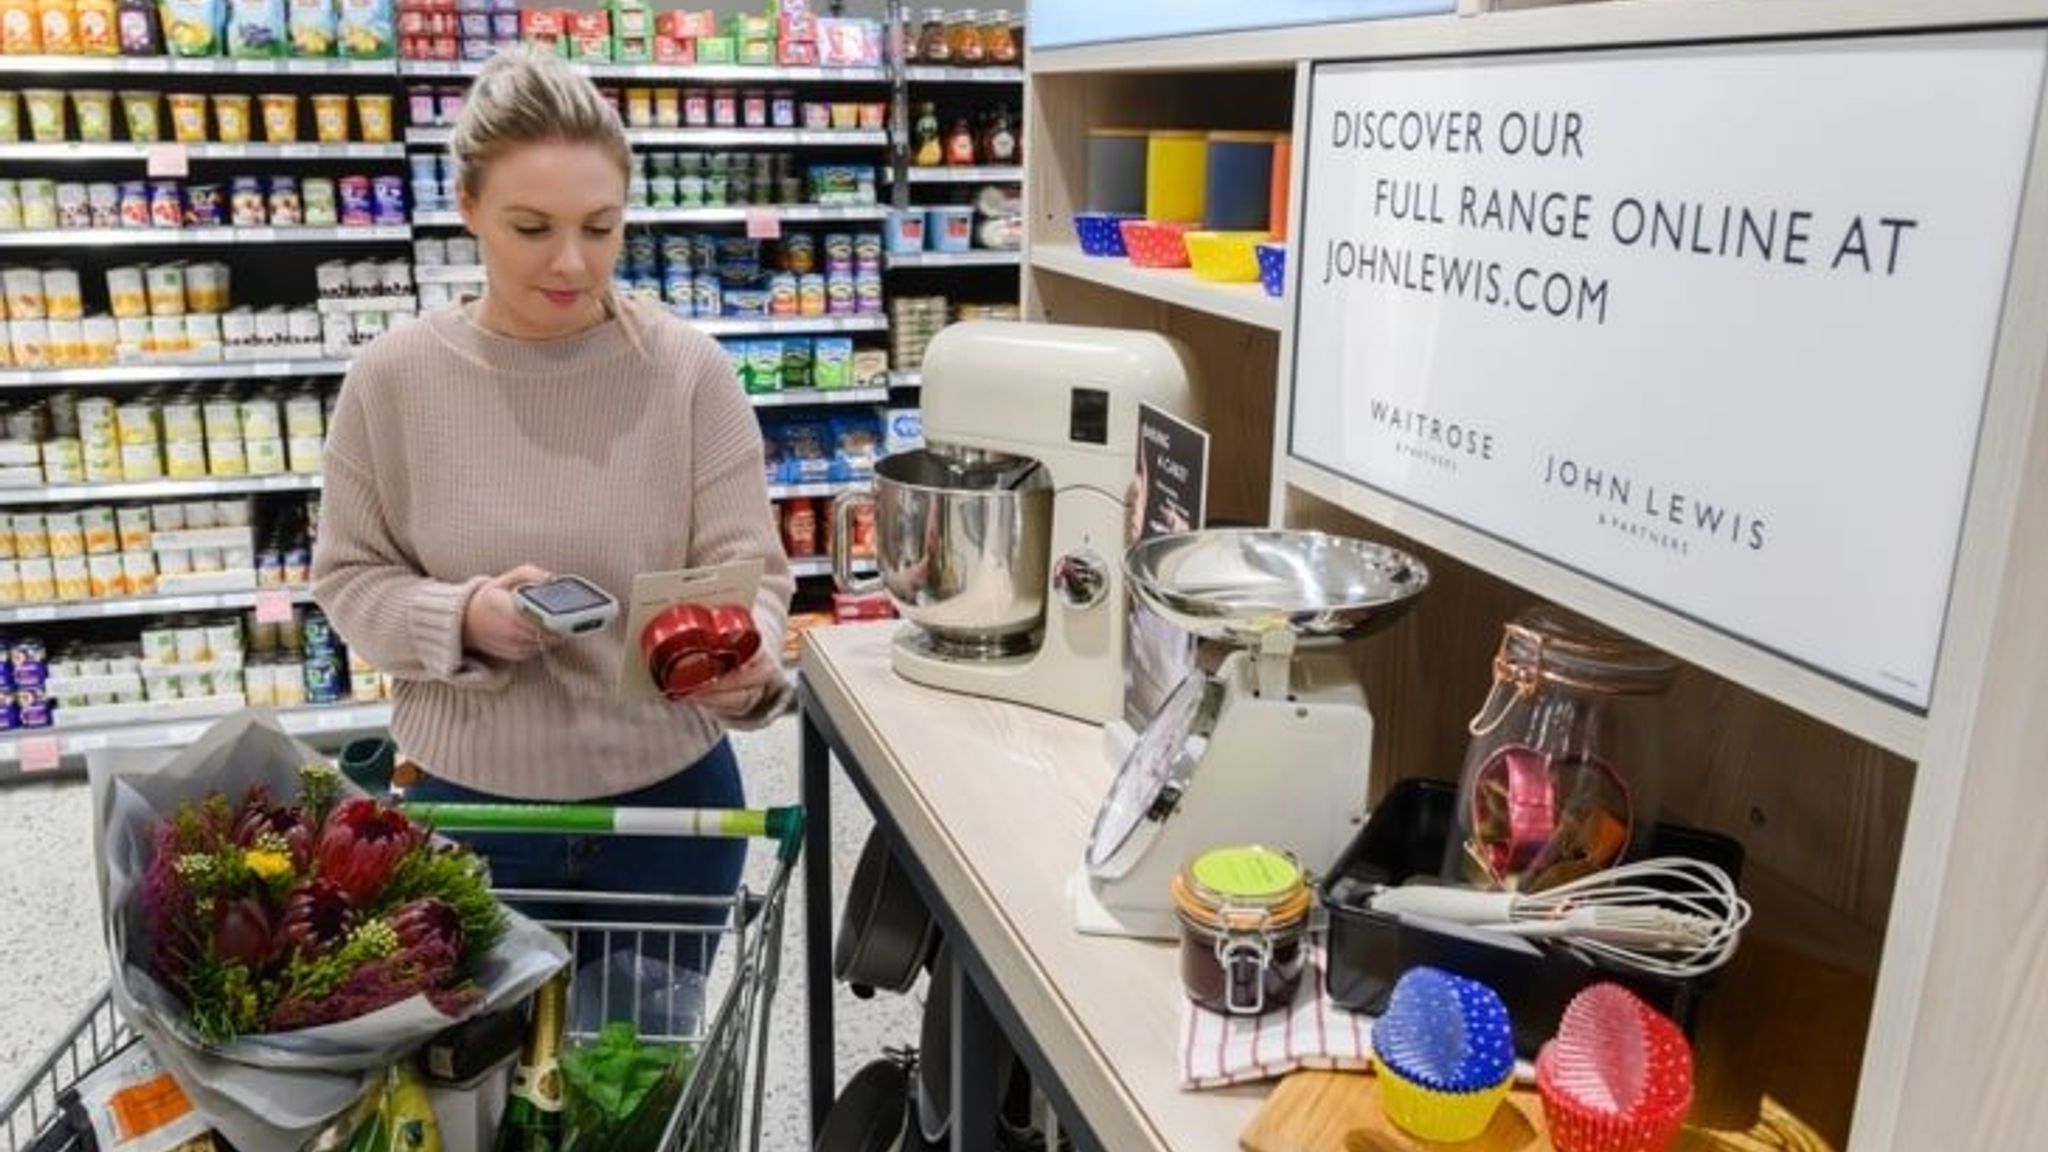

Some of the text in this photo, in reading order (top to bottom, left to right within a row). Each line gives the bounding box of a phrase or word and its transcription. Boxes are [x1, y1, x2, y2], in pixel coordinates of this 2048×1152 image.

[1332, 110, 1585, 159] DISCOVER OUR
[1374, 178, 1919, 276] FULL RANGE ONLINE AT
[1323, 238, 1609, 326] JOHNLEWIS.COM
[1371, 399, 1494, 461] WAITROSE
[1544, 454, 1766, 551] JOHN LEWIS
